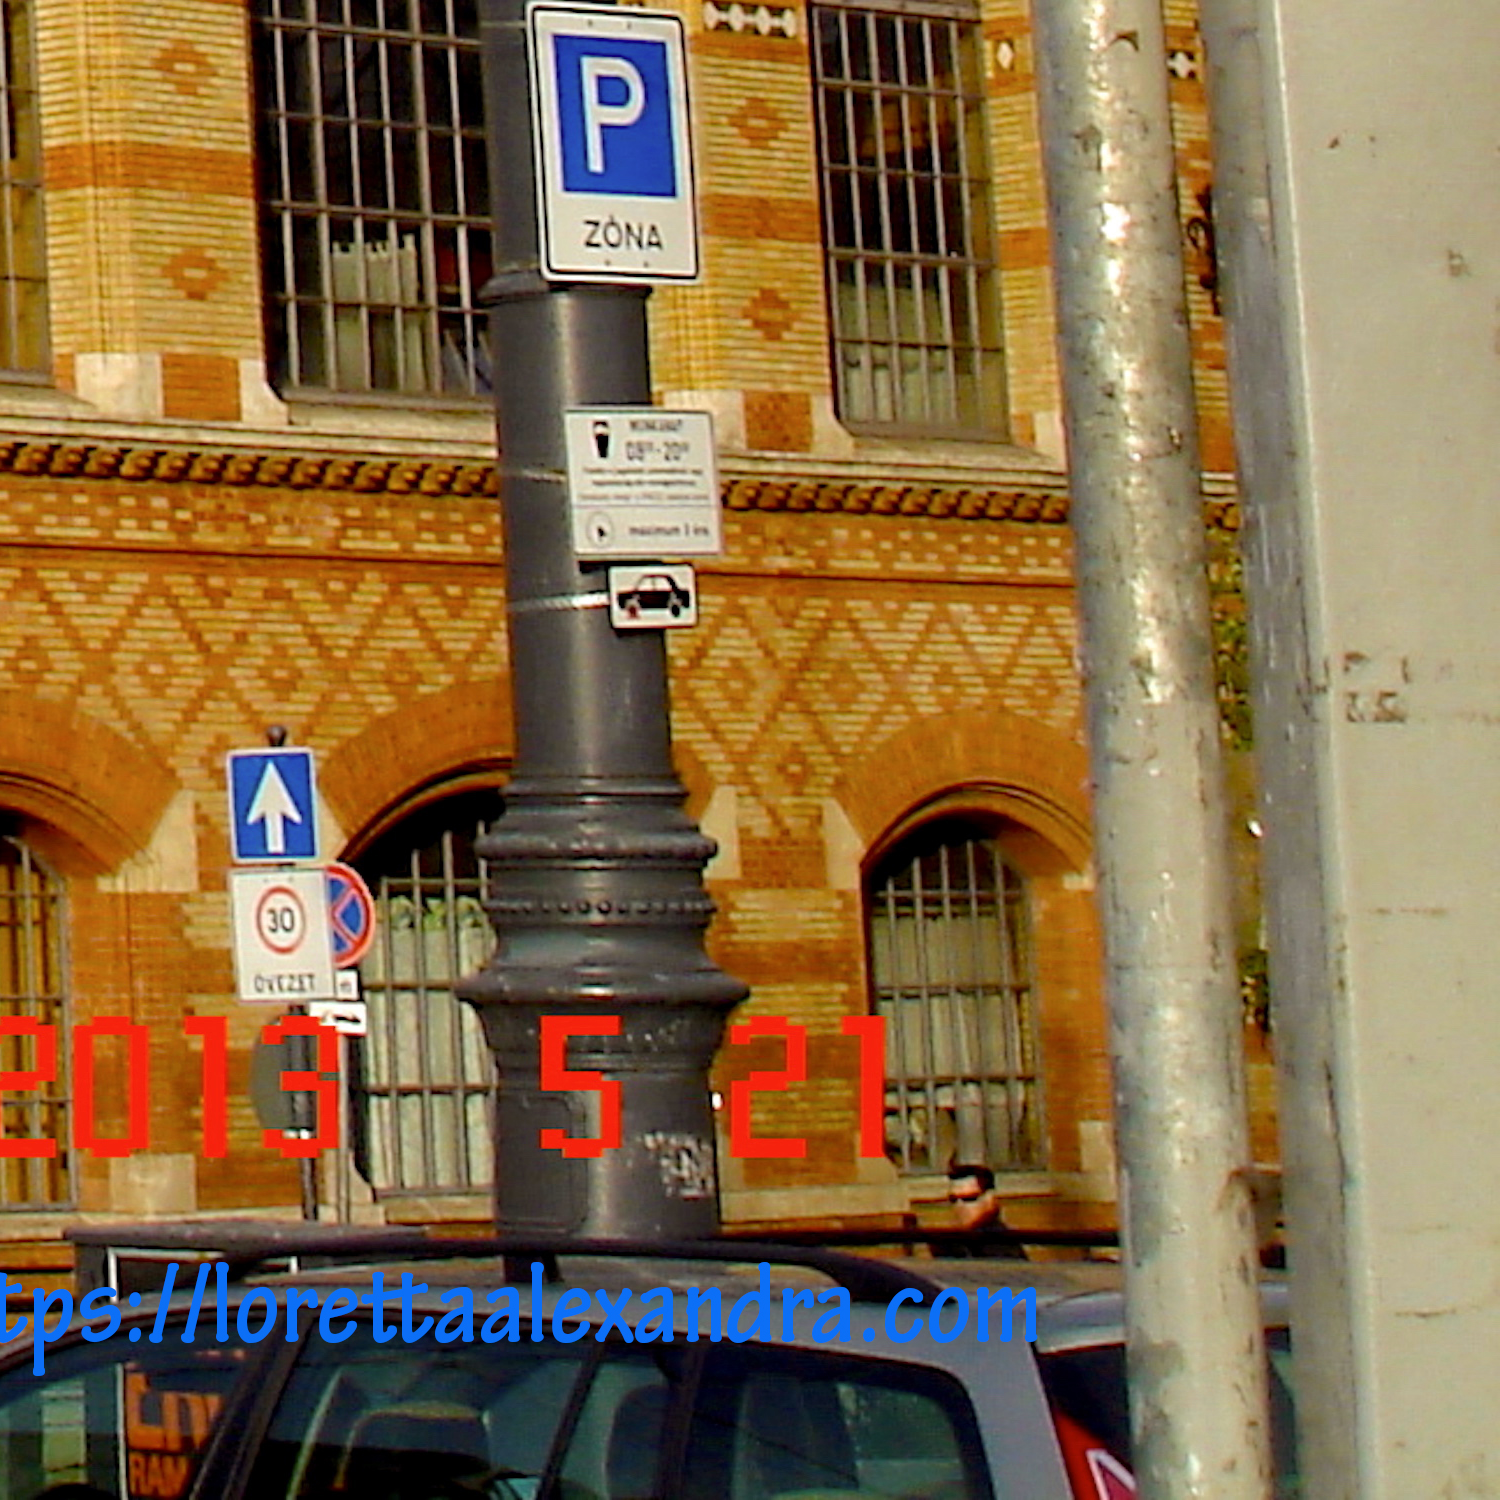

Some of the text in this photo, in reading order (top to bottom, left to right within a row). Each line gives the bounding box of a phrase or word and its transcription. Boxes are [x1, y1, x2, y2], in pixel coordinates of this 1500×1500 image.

[580, 56, 646, 174] P
[583, 214, 664, 251] ZÓNA
[266, 907, 296, 934] 30
